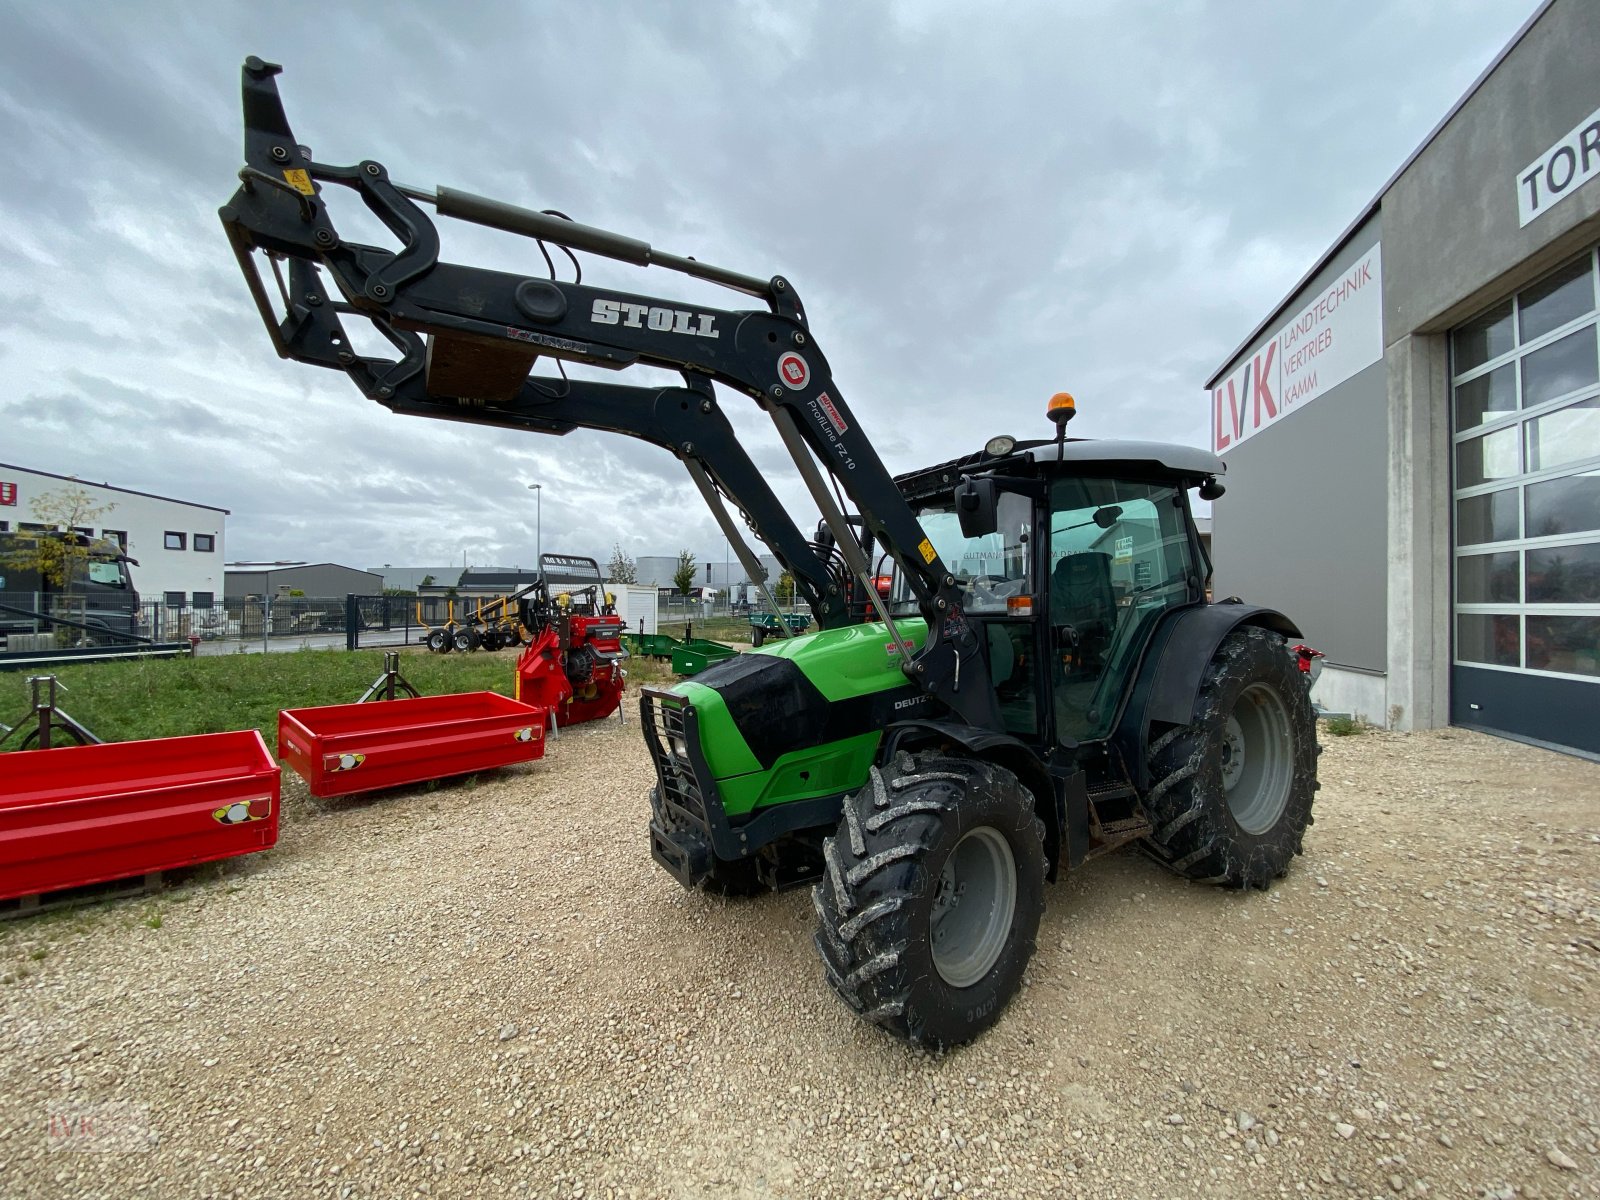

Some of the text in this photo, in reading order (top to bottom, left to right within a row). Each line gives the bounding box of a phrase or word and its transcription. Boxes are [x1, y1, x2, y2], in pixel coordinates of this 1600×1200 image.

[1522, 120, 1600, 211] TOR
[591, 299, 719, 338] STOLL
[1284, 258, 1372, 349] LANDTECHNIK
[1284, 327, 1332, 377] VERTRIEB
[1215, 340, 1278, 452] LVK
[1284, 370, 1318, 406] KAMM
[807, 400, 856, 470] ProfiLine FZ 10
